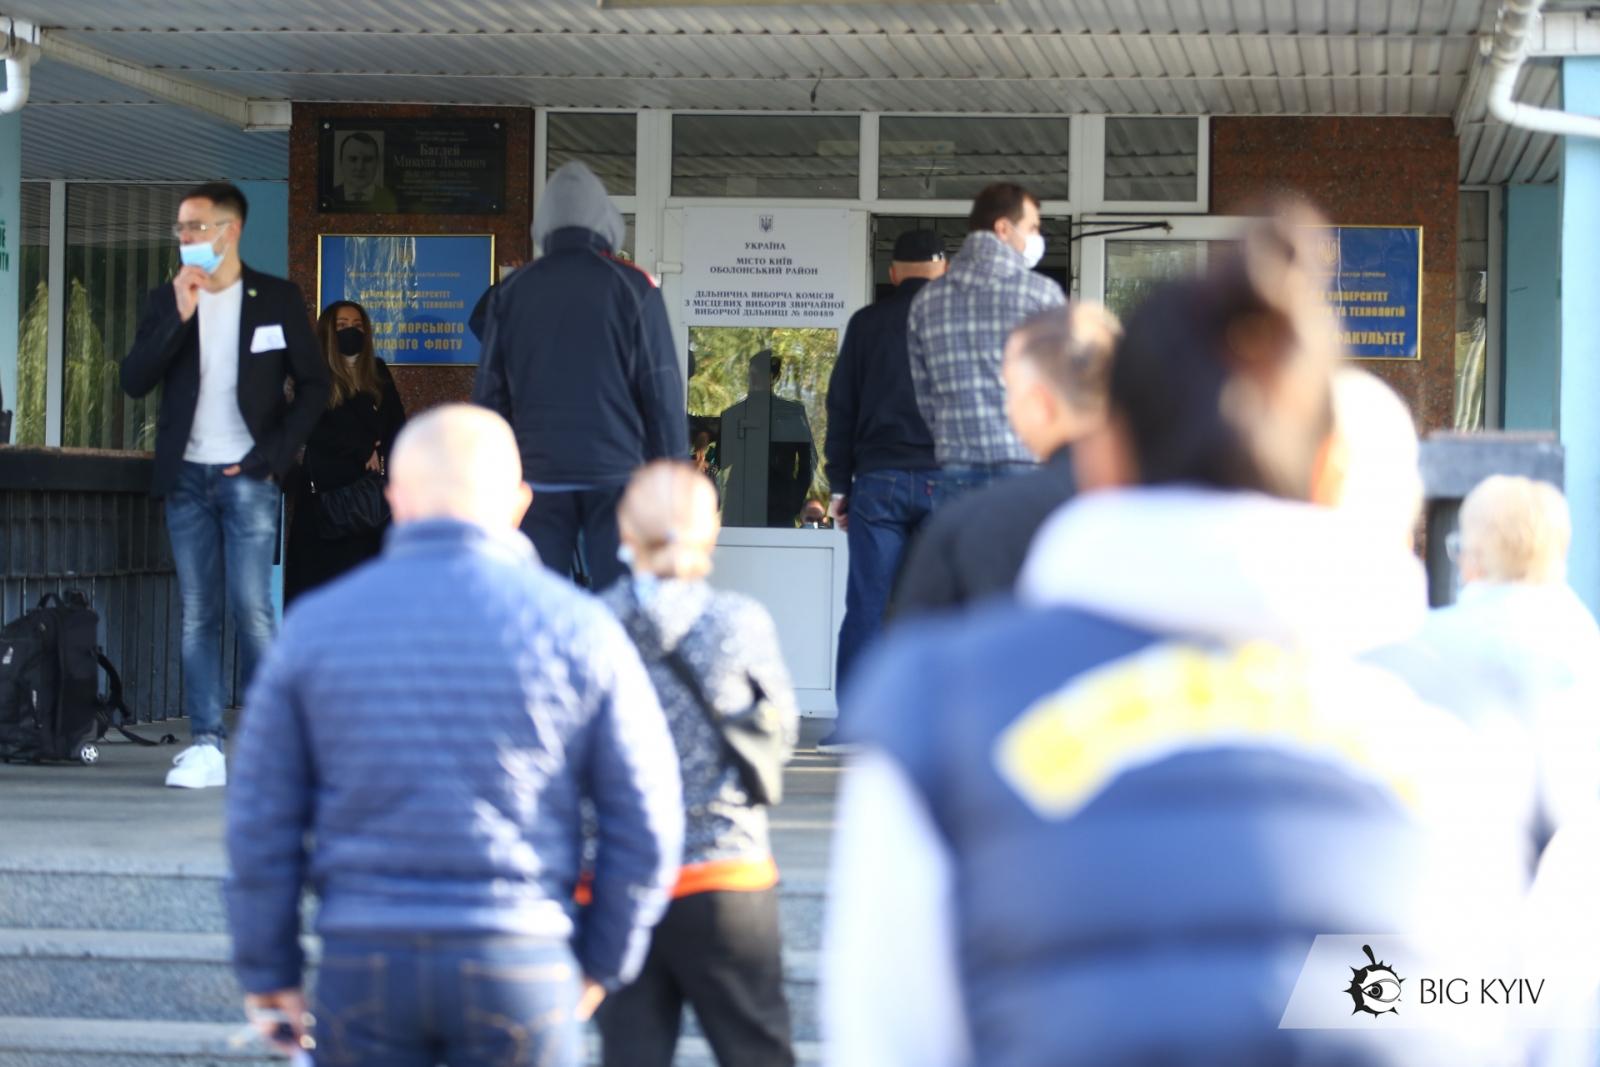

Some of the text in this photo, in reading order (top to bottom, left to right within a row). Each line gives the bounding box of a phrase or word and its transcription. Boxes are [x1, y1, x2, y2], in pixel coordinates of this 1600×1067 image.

[745, 241, 786, 250] УКРАЇНА
[736, 257, 792, 265] МІСТО КИЇВ
[710, 266, 818, 275] ОБОЛОНСЬКИЙ РАЙОН
[695, 290, 748, 299] ДІЛЬНИЧНА
[751, 291, 792, 299] ВИБОРЧА
[694, 300, 742, 308] МІСЦЕВИХ
[745, 300, 786, 308] ВИБОРІВ
[790, 300, 844, 309] ЗВИЧАЙНОЇ
[694, 308, 740, 316] ВИБОРЧОЇ
[743, 309, 788, 317] ДІЛЬНИЦІ
[398, 322, 464, 334] МОРСЬКОГО
[424, 338, 462, 350] ФЛОТУ
